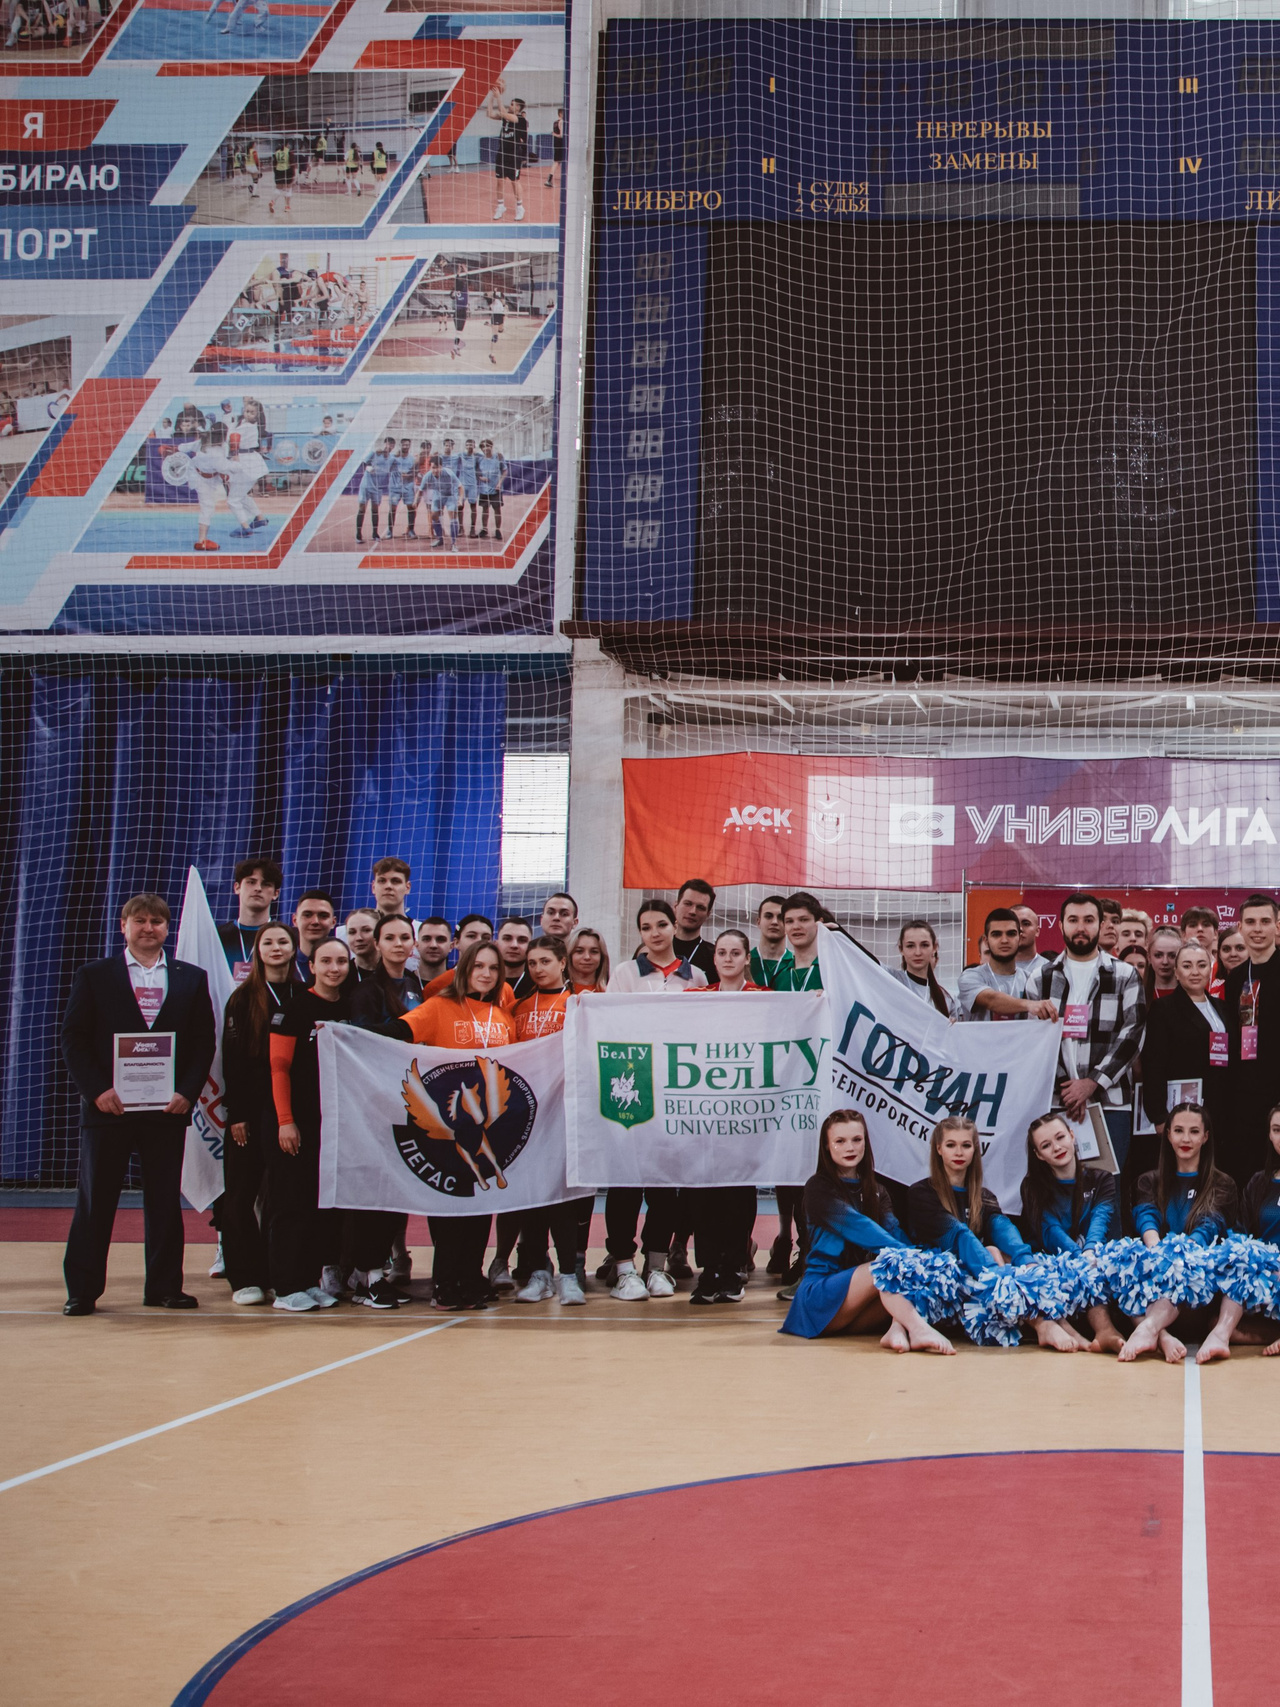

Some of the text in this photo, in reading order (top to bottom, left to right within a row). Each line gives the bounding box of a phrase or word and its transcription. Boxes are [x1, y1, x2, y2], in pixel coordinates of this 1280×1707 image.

[22, 111, 44, 139] Я
[915, 120, 1052, 139] ПЕРЕРЫВЫ
[928, 152, 1039, 171] ЗАМЕНЫ
[1179, 157, 1203, 174] IV
[809, 181, 870, 196] СУДЬЯ
[612, 189, 723, 211] ЛИБЕРО
[795, 198, 870, 213] 2 СУДЬЯ
[723, 805, 793, 828] АССК
[965, 803, 1278, 847] УНИВЕРЛИГА
[1154, 914, 1182, 924] СВО
[600, 1045, 649, 1060] БелГУ
[705, 1042, 756, 1060] НИУ
[662, 1037, 831, 1090] БелГУ
[837, 1000, 1009, 1127] ГОРИН
[664, 1098, 776, 1117] BELGOROD
[665, 1115, 785, 1136] UNIVERSITY
[400, 1138, 457, 1192] ПЕГАС
